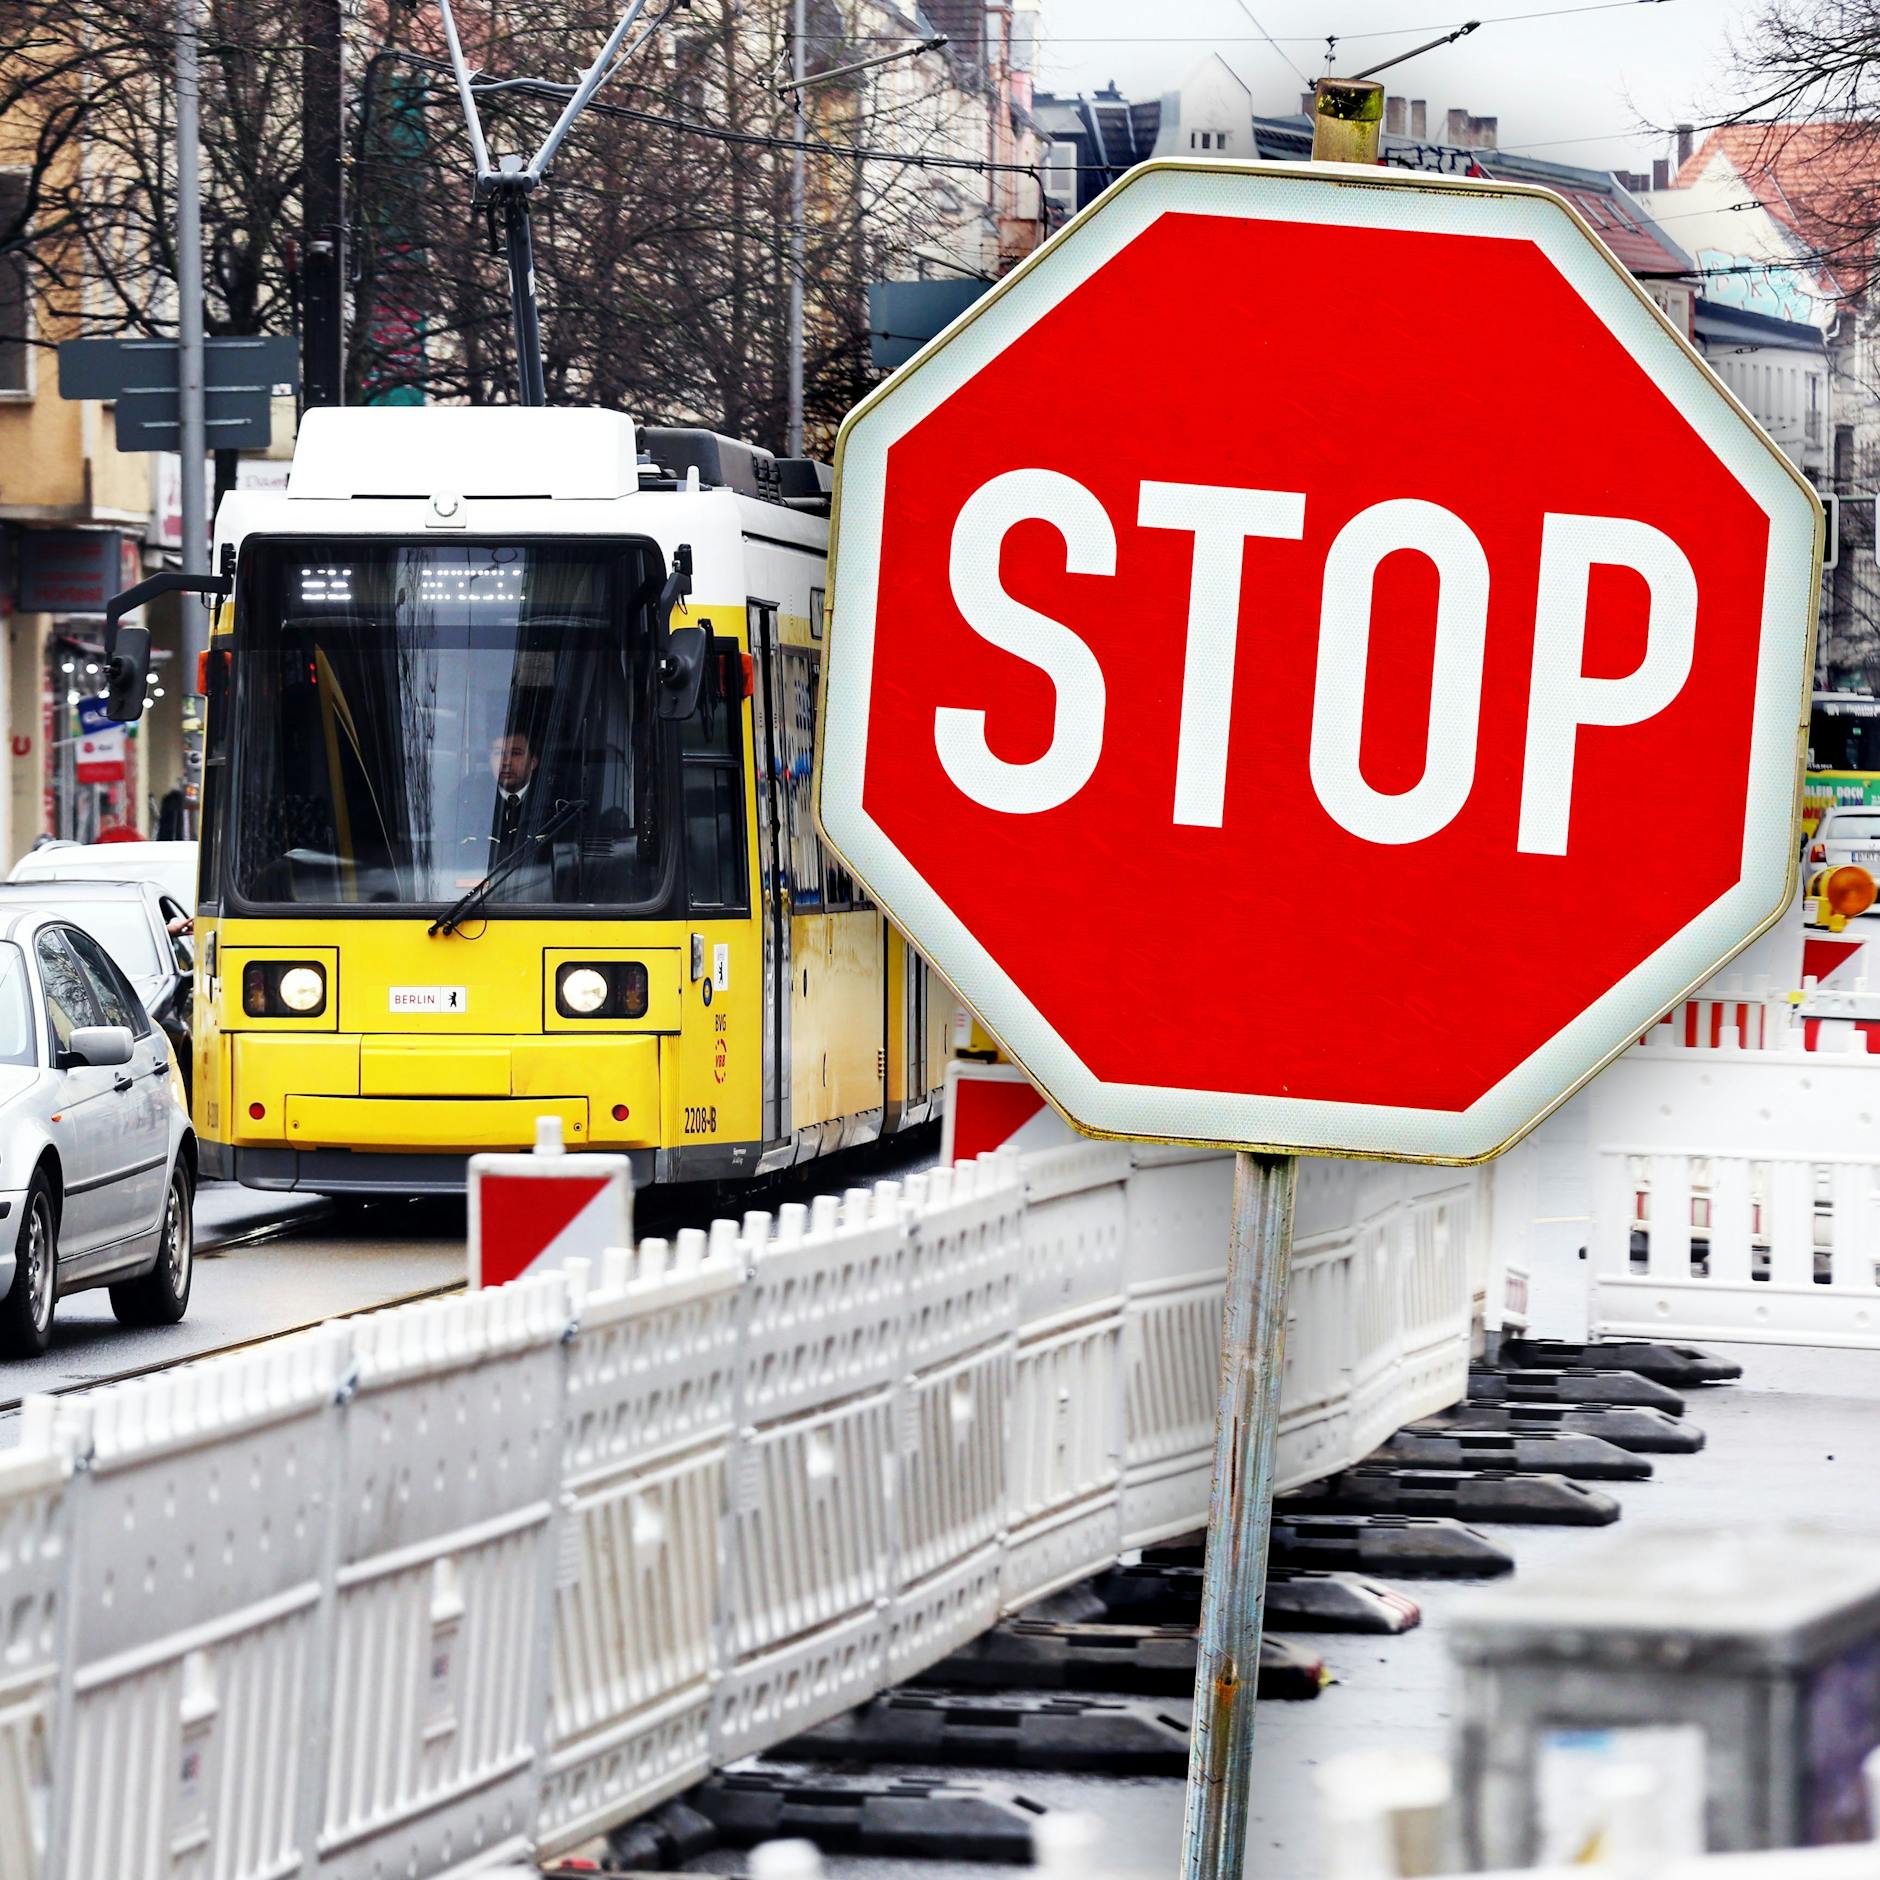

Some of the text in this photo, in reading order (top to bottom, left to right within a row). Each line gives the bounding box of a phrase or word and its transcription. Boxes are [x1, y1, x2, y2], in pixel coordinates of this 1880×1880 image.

[934, 467, 1699, 856] STOP
[1837, 786, 1864, 799] DOCH
[394, 994, 436, 1005] BERLIN
[715, 1014, 727, 1031] BVG
[715, 1055, 726, 1067] VBB
